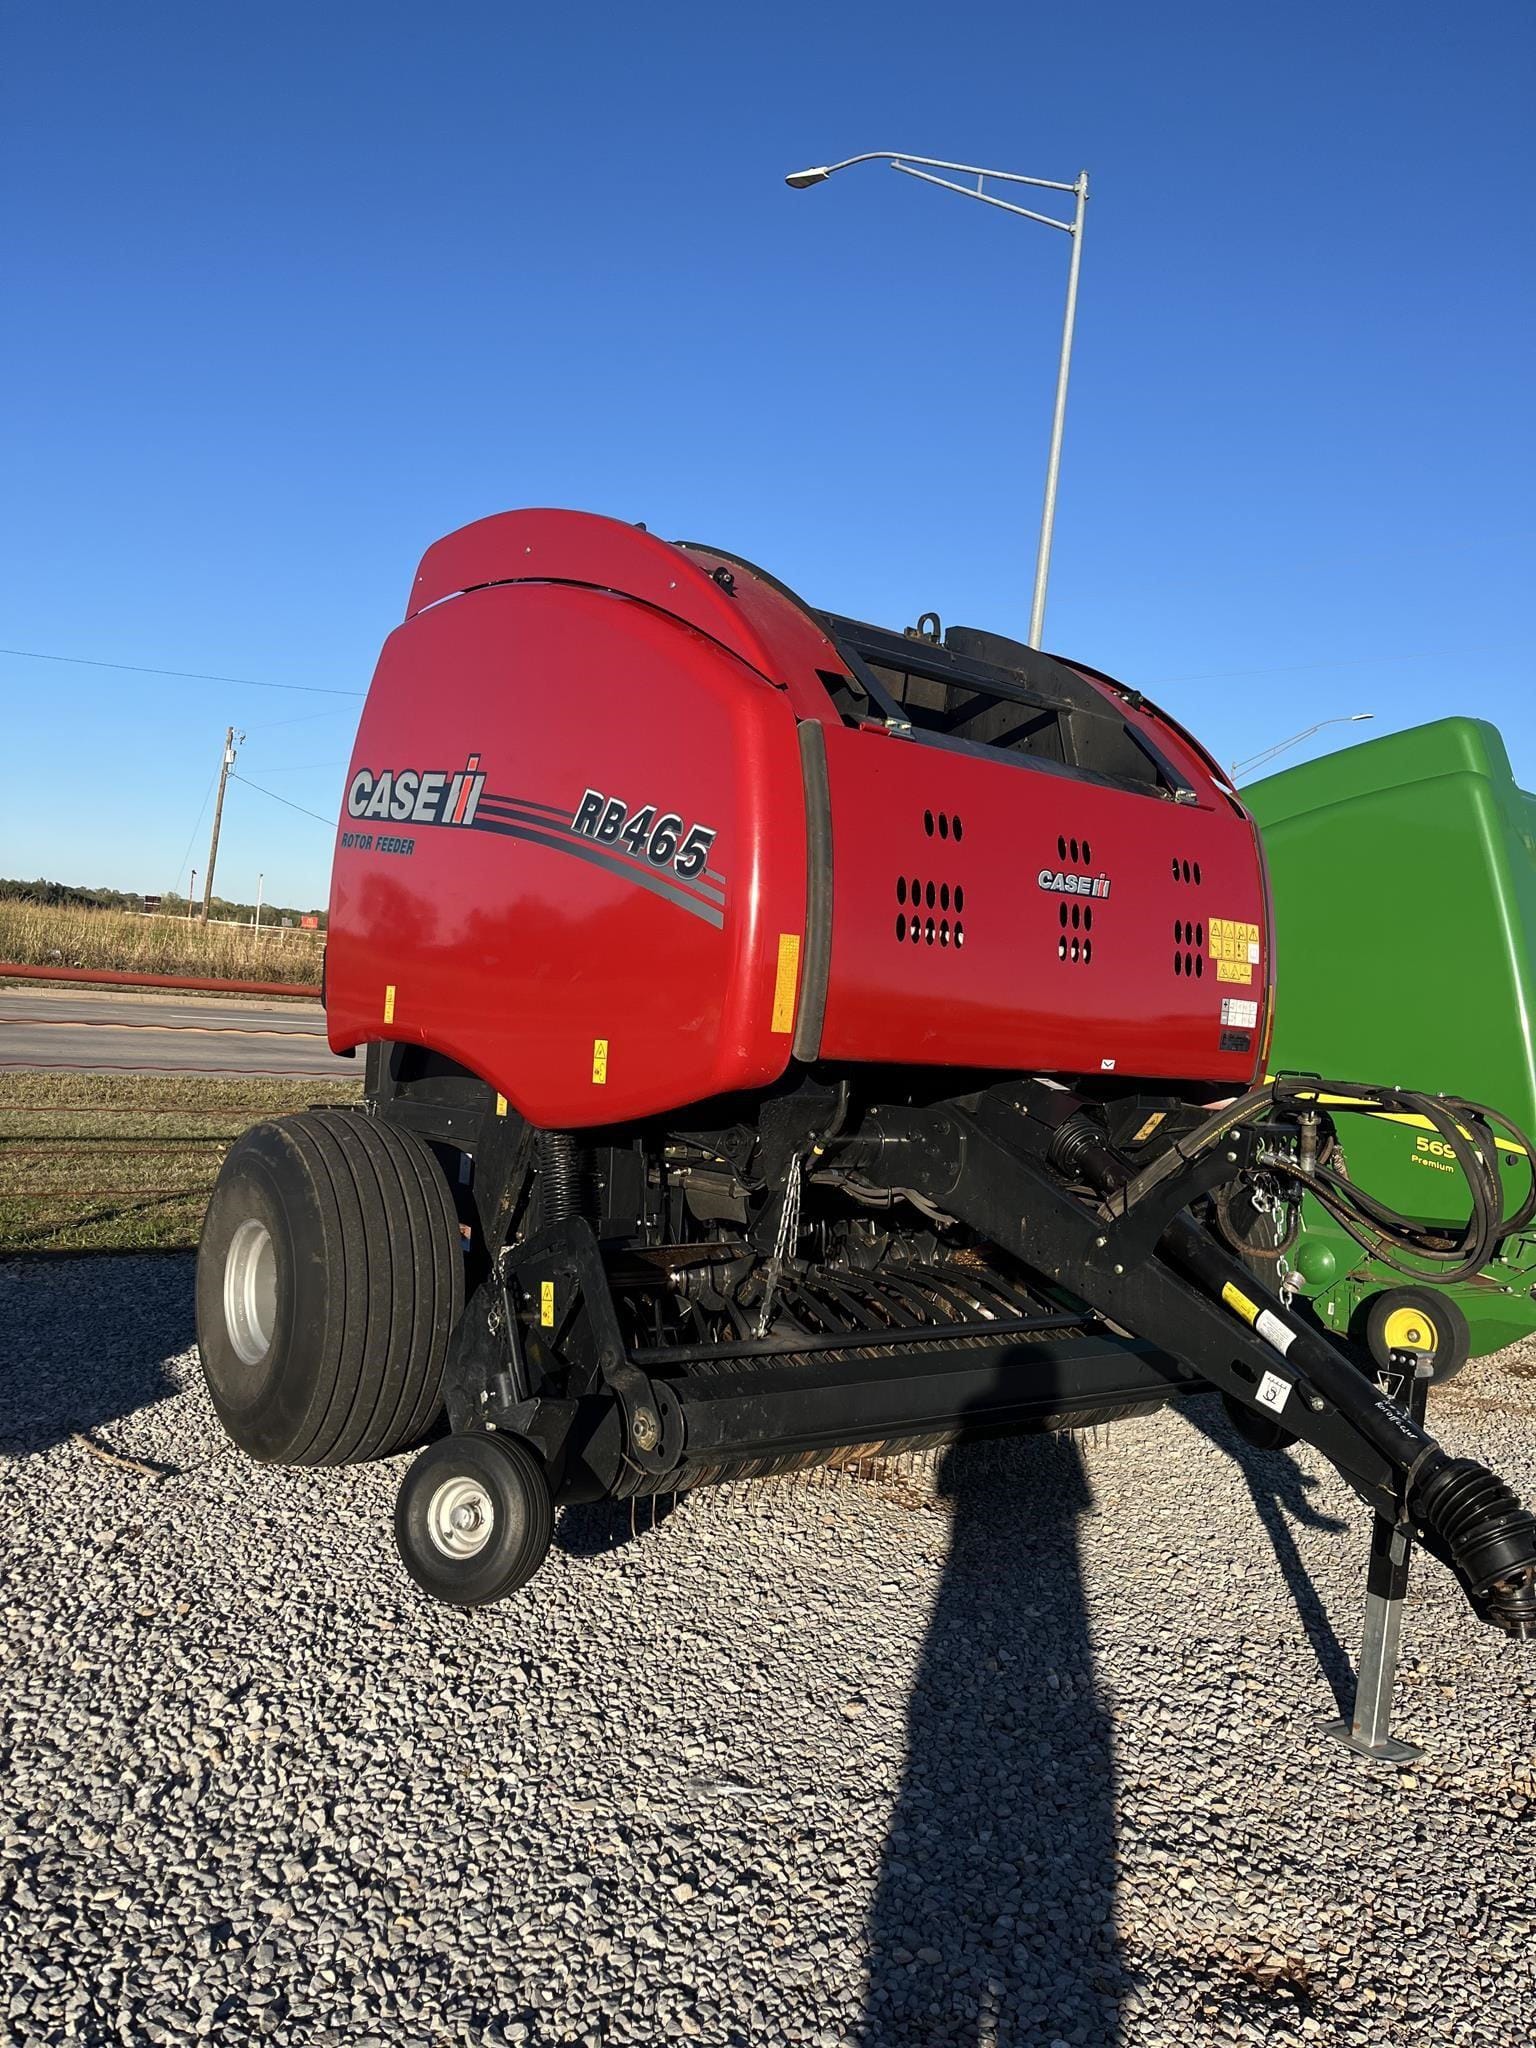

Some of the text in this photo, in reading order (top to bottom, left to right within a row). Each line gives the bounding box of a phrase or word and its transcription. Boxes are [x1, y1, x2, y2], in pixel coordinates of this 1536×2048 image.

[347, 769, 447, 822] CASE
[341, 832, 415, 855] ROTOR FEEDER
[570, 788, 718, 881] RB465
[1038, 870, 1092, 895] CASE
[1411, 1154, 1454, 1174] Premium
